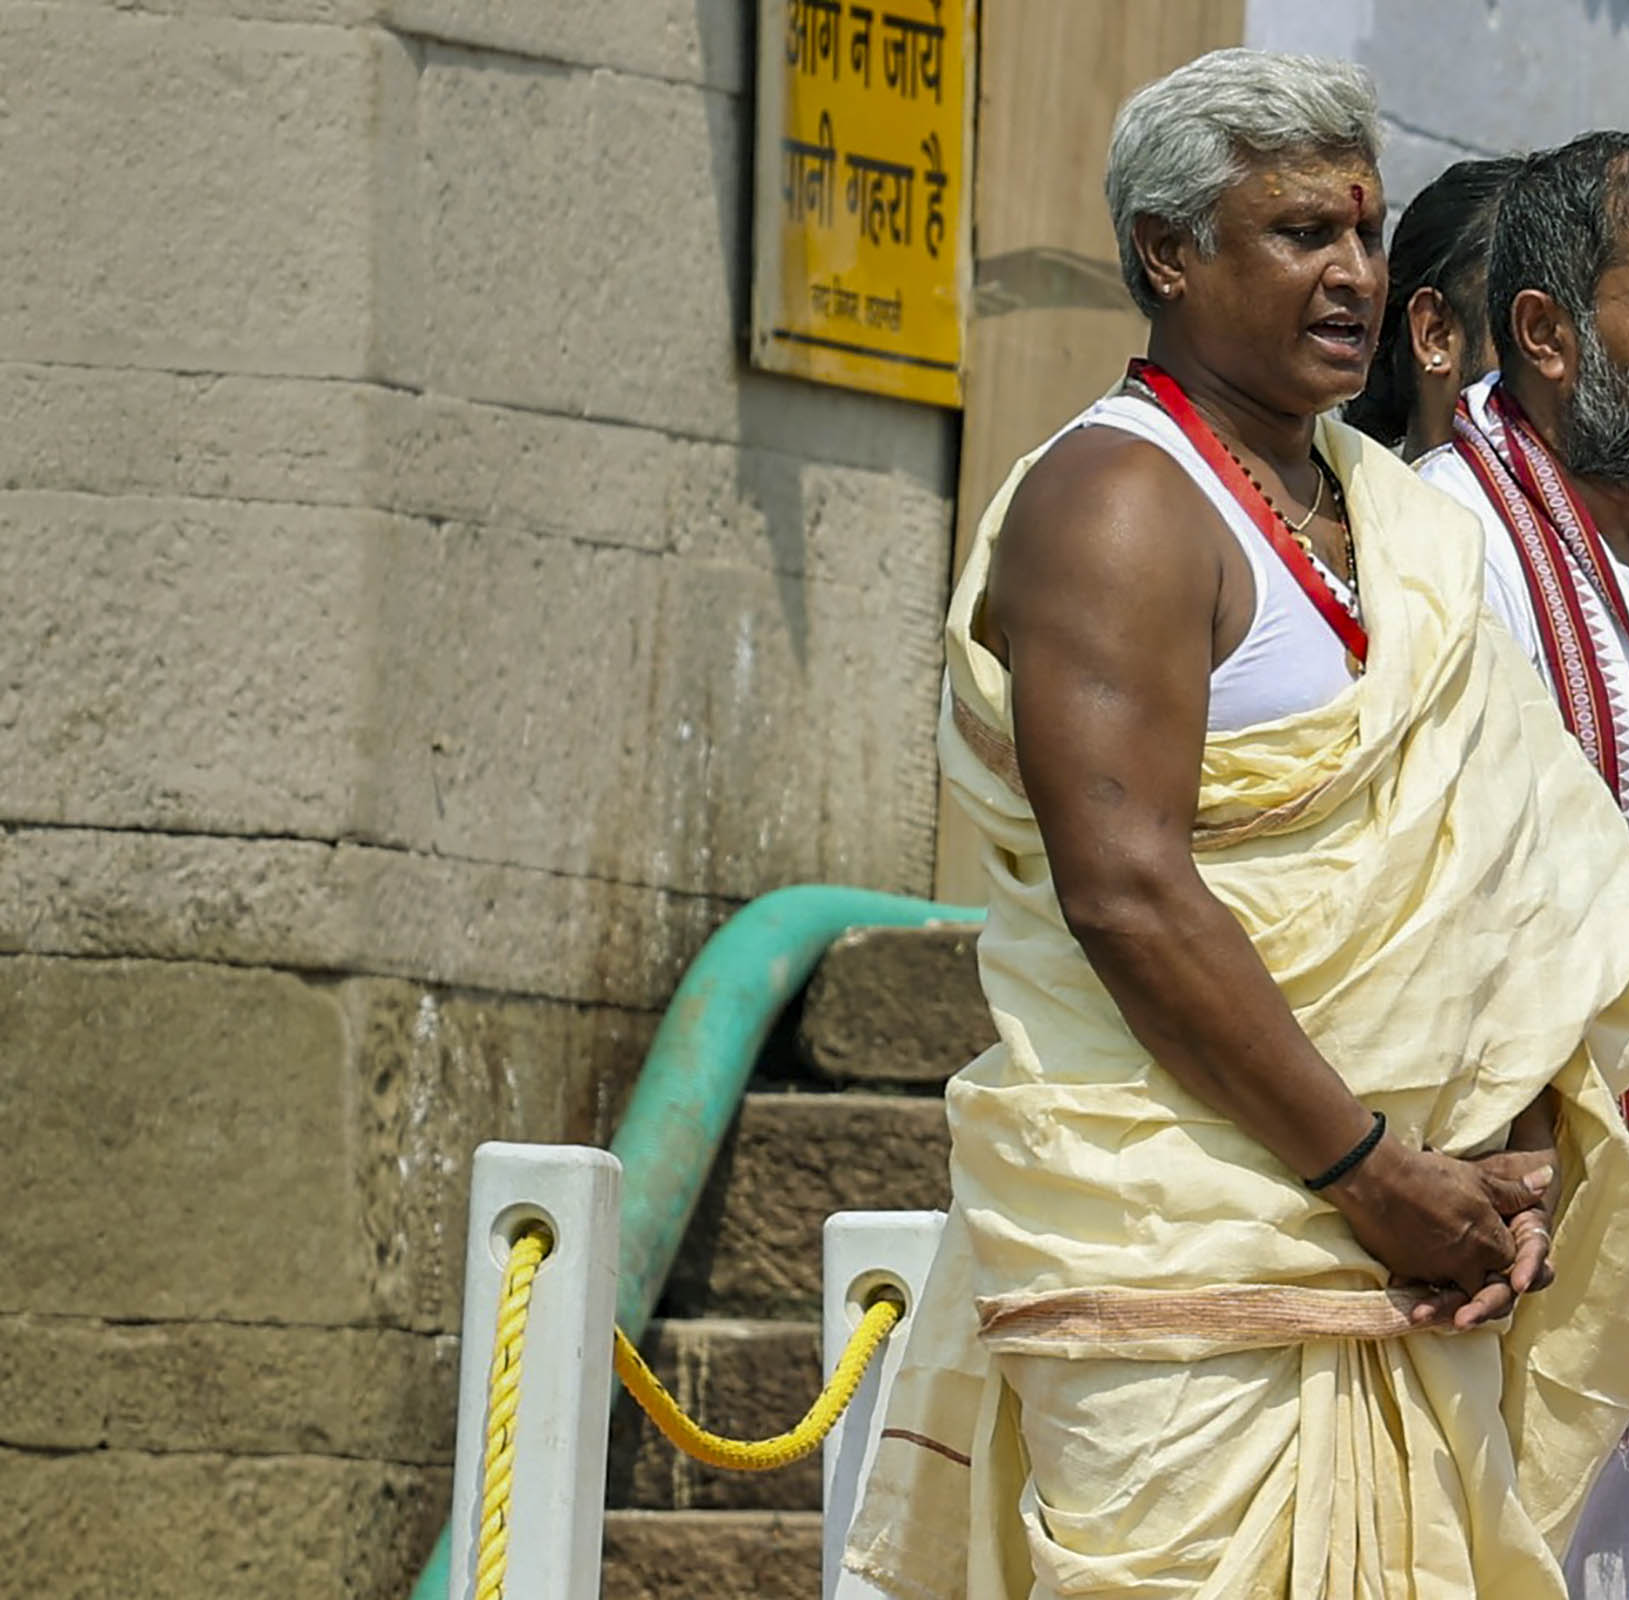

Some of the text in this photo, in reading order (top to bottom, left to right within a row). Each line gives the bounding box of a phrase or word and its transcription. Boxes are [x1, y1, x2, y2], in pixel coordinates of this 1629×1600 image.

[850, 5, 873, 89] न
[847, 153, 914, 247] गहरा
[921, 131, 947, 260] है
